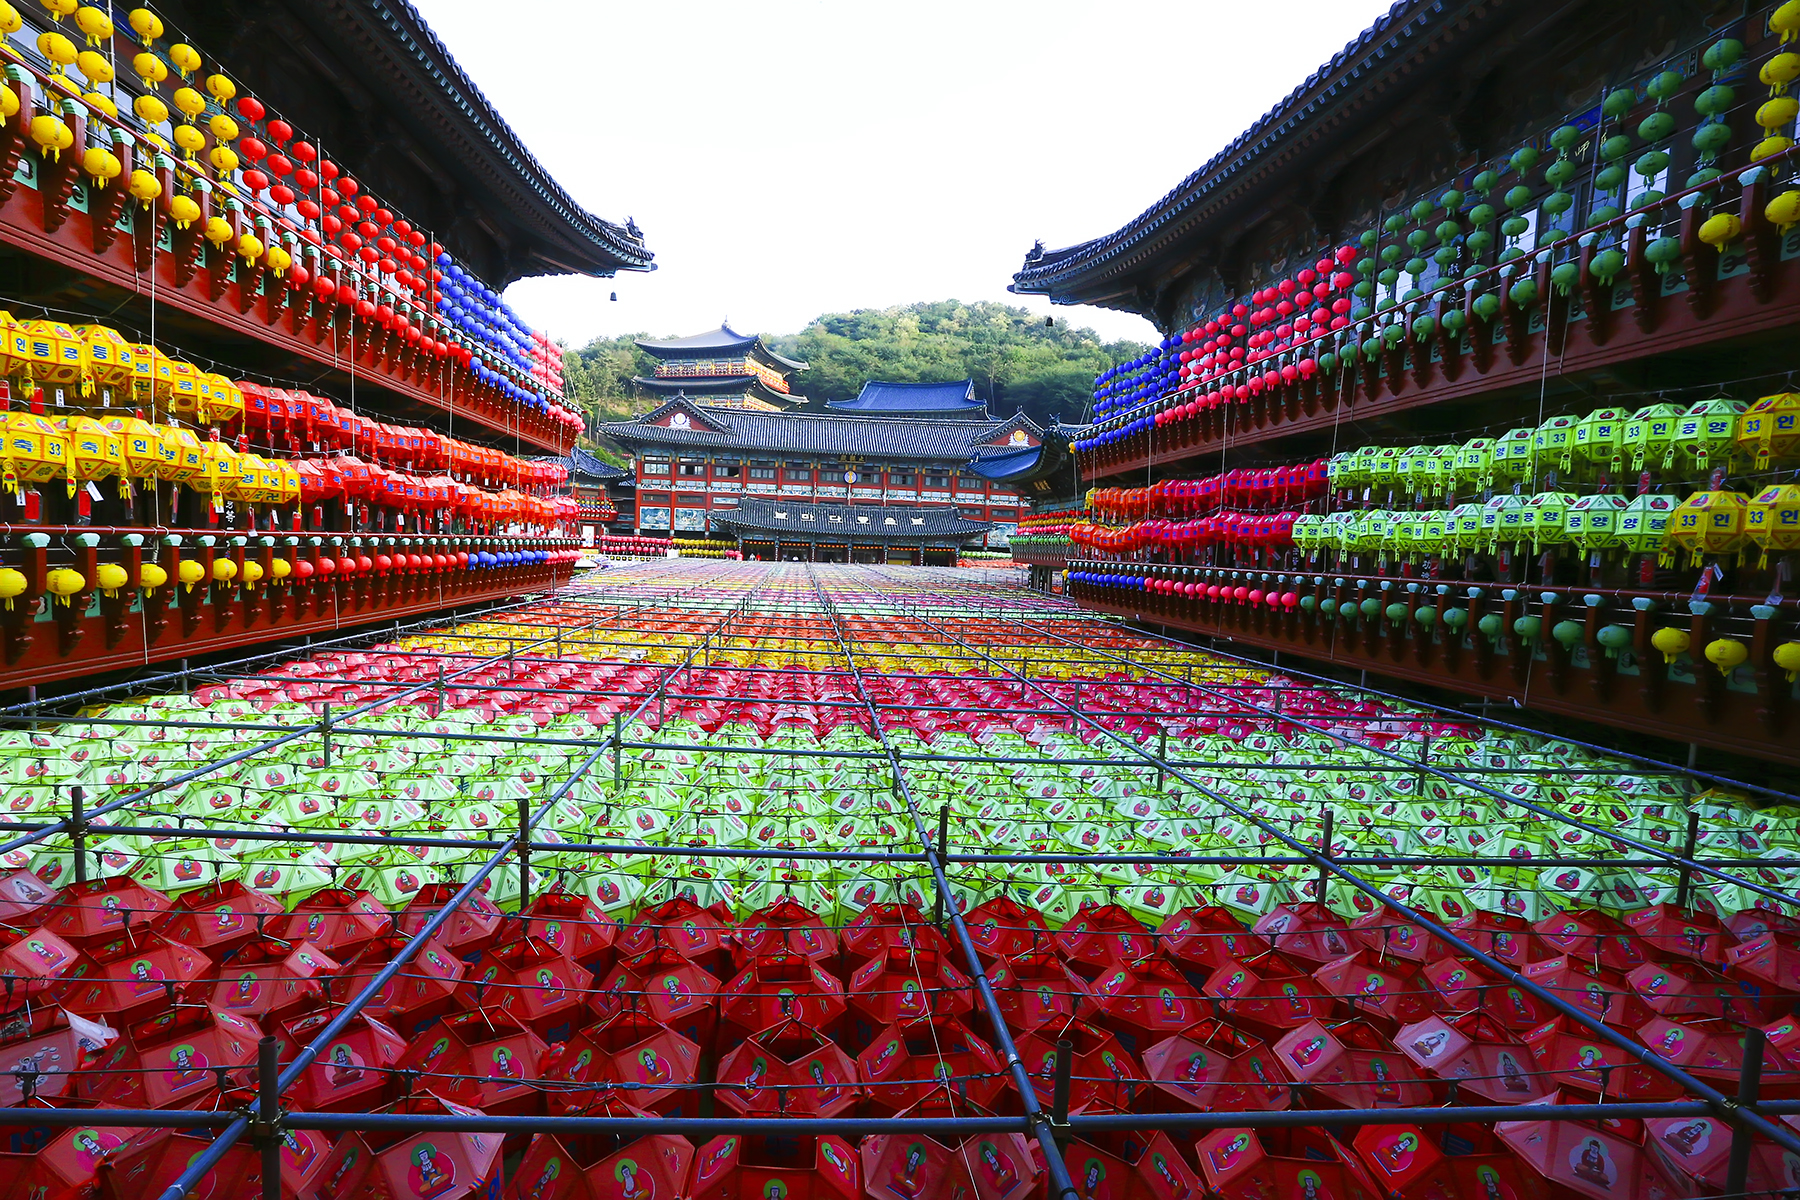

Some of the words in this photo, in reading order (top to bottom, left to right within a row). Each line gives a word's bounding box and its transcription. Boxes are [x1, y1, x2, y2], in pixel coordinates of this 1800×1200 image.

[16, 338, 26, 353] 인
[33, 342, 50, 357] 등
[92, 345, 108, 360] 등
[1628, 426, 1640, 438] 33
[1652, 422, 1667, 435] 인
[1682, 423, 1696, 434] 공
[1708, 421, 1728, 433] 양
[1746, 419, 1761, 433] 33
[1777, 415, 1795, 430] 인
[1553, 433, 1566, 443] 33
[1577, 428, 1586, 440] 인
[1598, 426, 1611, 437] 헌
[49, 442, 61, 456] 33
[133, 440, 147, 453] 인
[1468, 454, 1479, 463] 33
[218, 461, 229, 473] 인
[1485, 514, 1495, 524] 공
[1504, 514, 1519, 523] 양
[1524, 512, 1534, 522] 공
[1543, 511, 1558, 521] 양
[1569, 517, 1581, 527] 공
[1591, 517, 1609, 527] 양
[1681, 515, 1697, 527] 33
[1713, 514, 1730, 527] 인
[1749, 511, 1764, 523] 33
[1780, 510, 1799, 524] 인
[1373, 523, 1381, 532] 인
[1463, 521, 1476, 530] 양
[1623, 518, 1638, 529] 양
